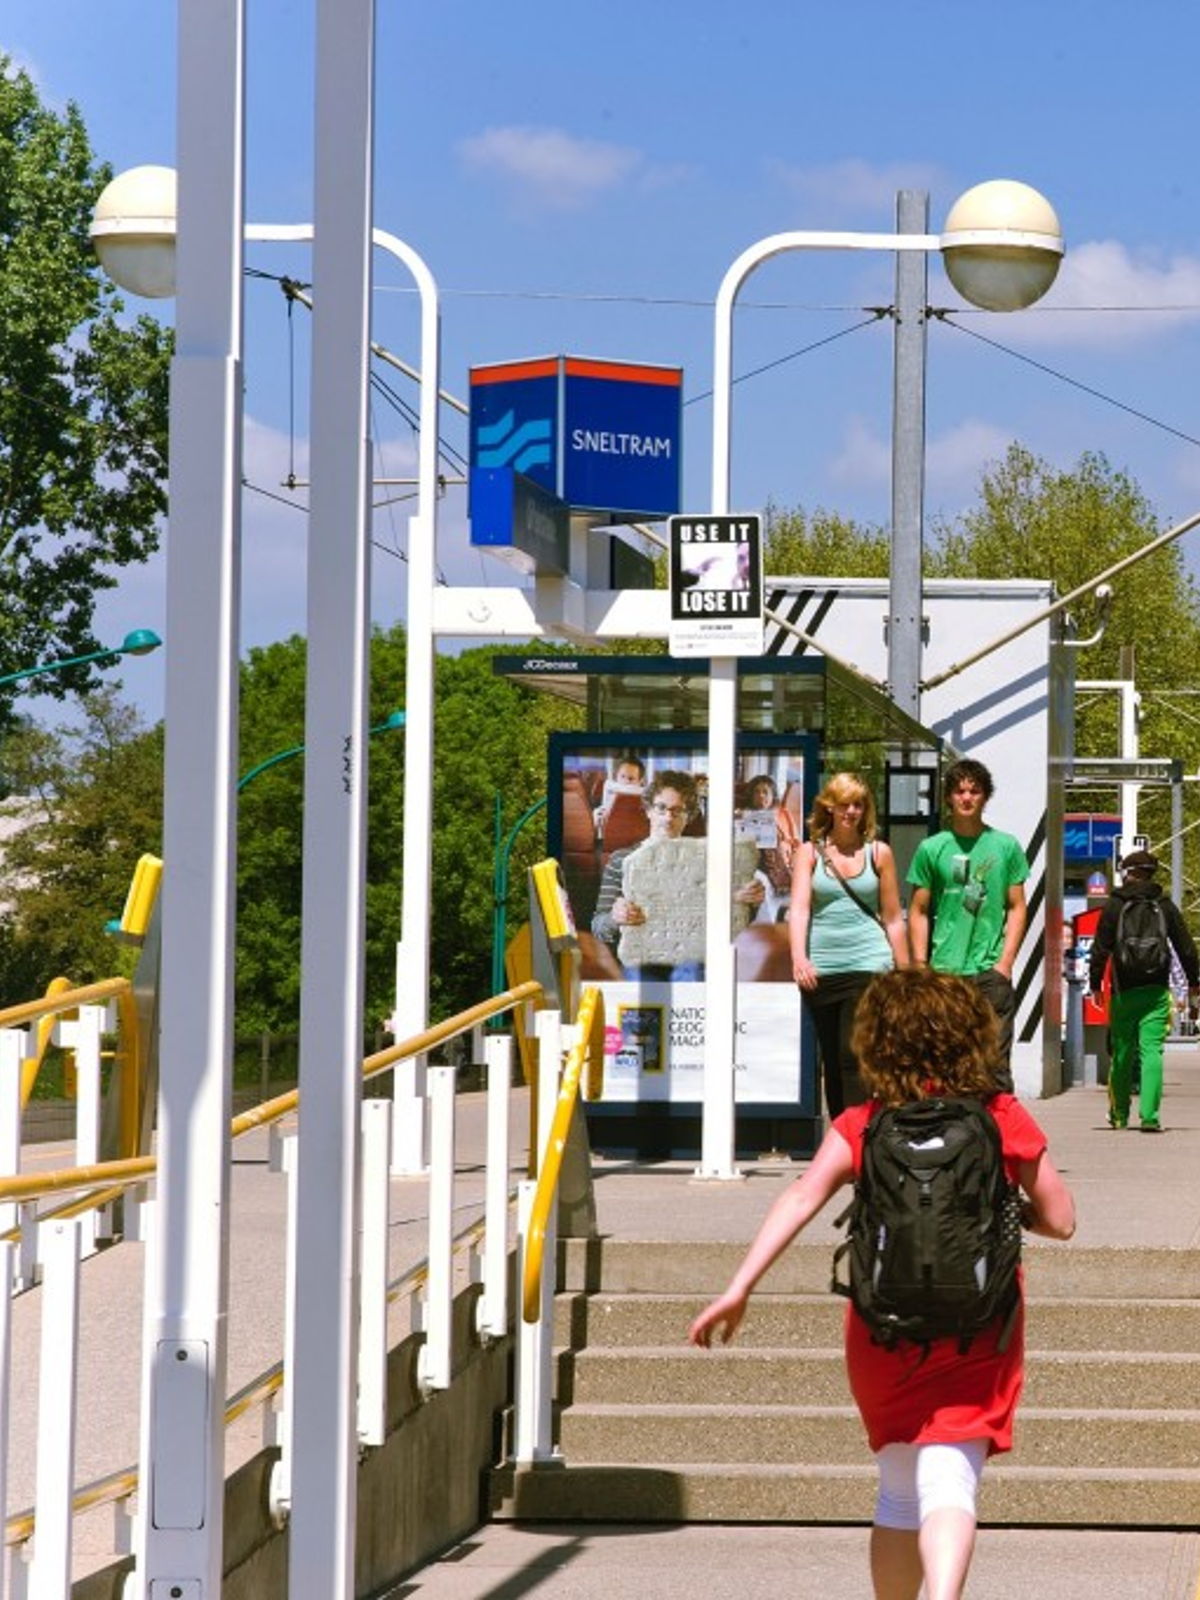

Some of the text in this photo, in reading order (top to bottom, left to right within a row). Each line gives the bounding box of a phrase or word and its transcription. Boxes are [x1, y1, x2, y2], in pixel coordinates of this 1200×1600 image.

[572, 429, 671, 459] SNELTRAM
[680, 523, 750, 541] USE IT
[681, 591, 750, 612] LOSE IT
